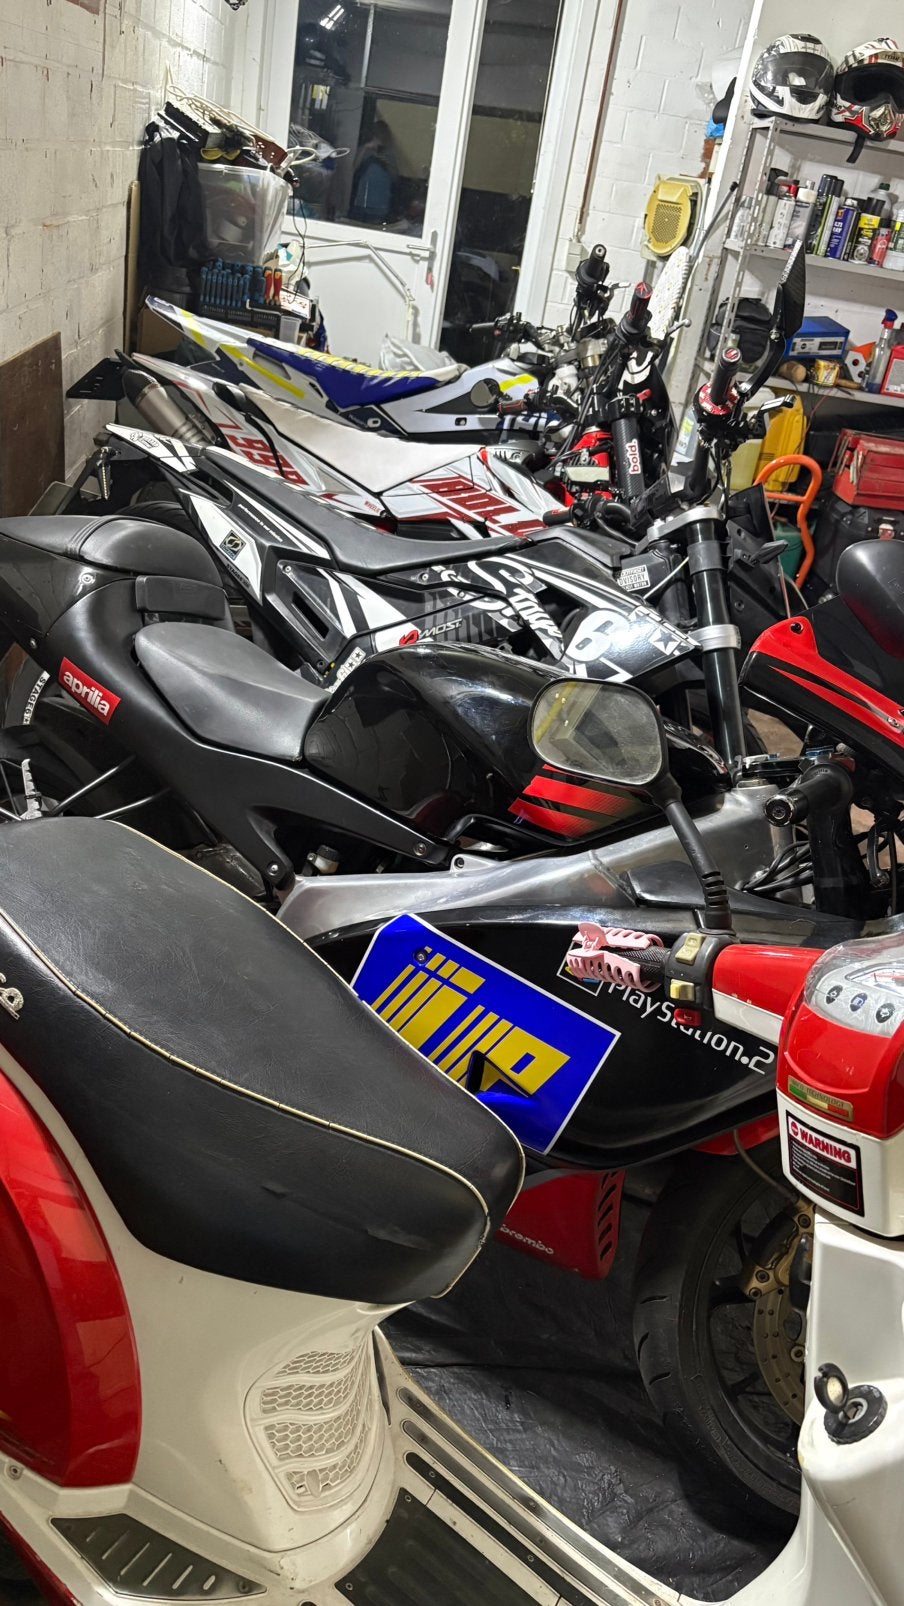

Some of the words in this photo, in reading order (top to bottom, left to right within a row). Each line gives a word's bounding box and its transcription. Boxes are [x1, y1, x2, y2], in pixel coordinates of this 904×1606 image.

[628, 440, 641, 474] bold.
[63, 671, 110, 717] aprilia
[799, 1128, 853, 1164] WARNING
[500, 1223, 554, 1255] brembo
